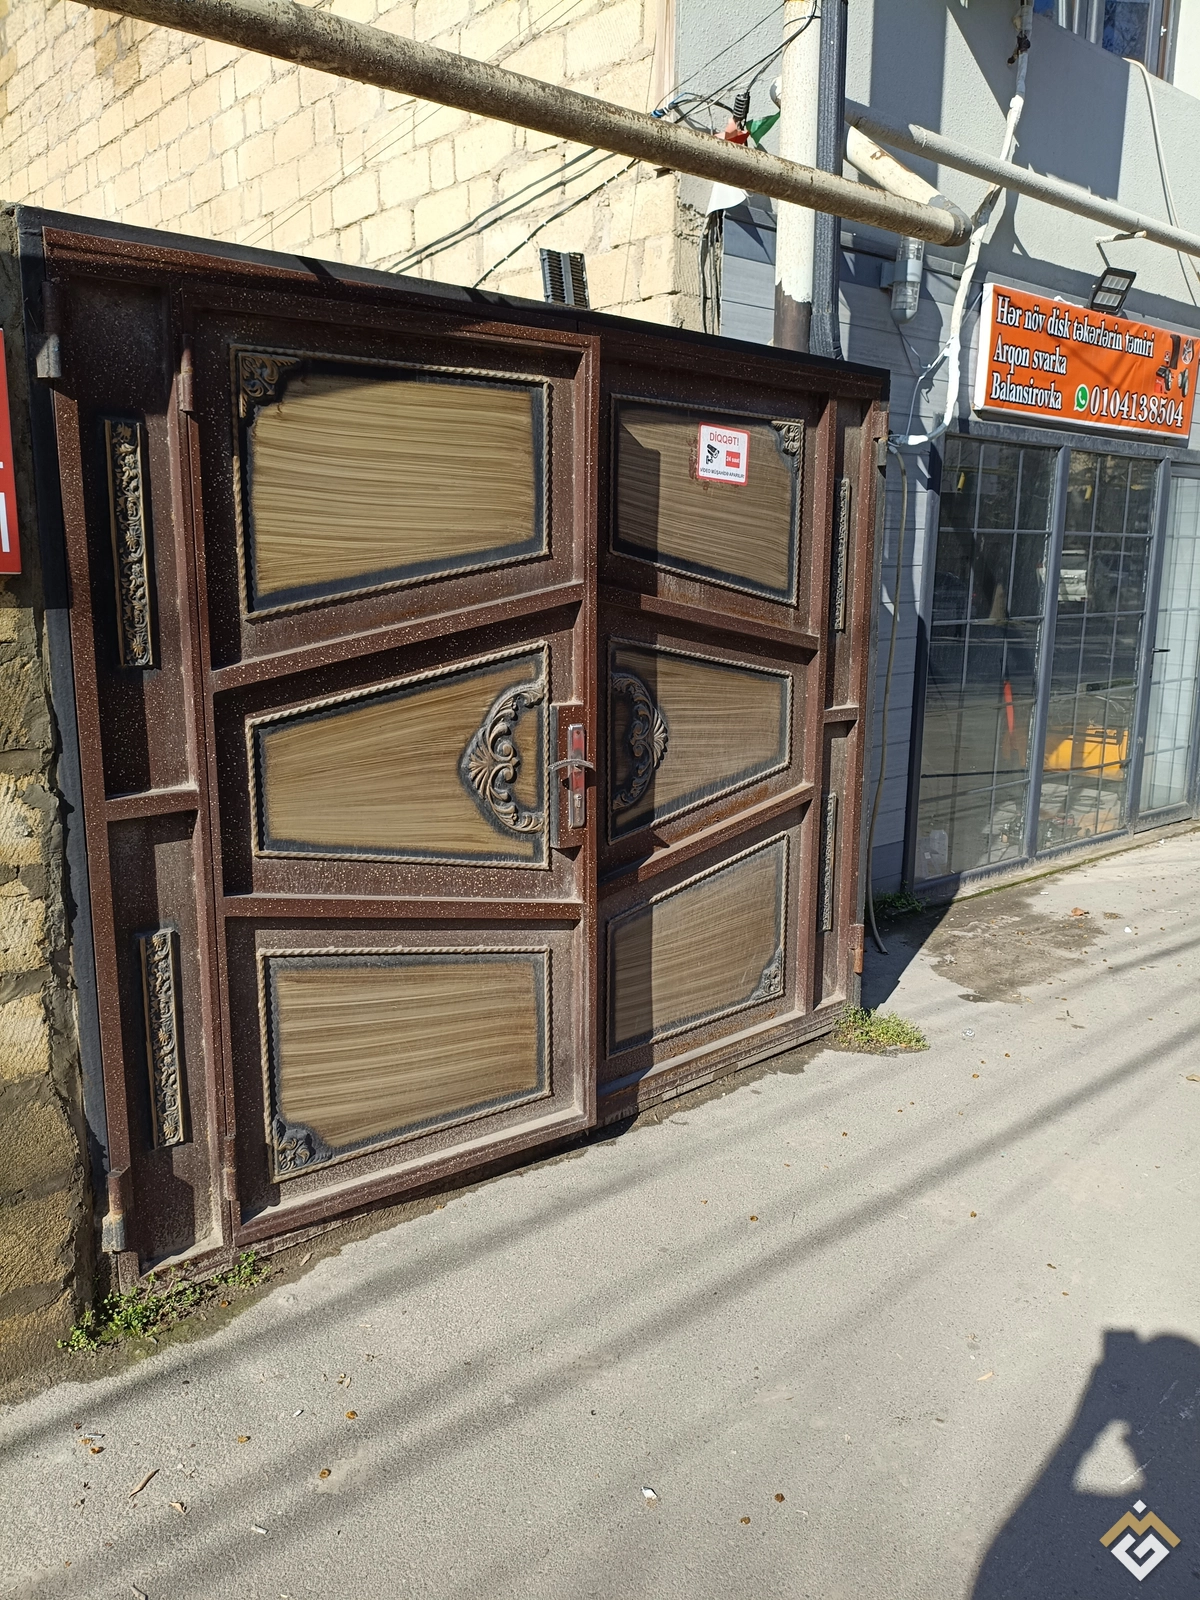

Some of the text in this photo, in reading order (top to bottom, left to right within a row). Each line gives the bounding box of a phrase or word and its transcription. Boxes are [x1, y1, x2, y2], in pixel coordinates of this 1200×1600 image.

[996, 295, 1155, 358] Hər növ disk təkərlərin təmiri
[993, 334, 1067, 375] Arqon svarka
[990, 371, 1062, 410] Balansirovka
[1089, 386, 1184, 427] 0104138504
